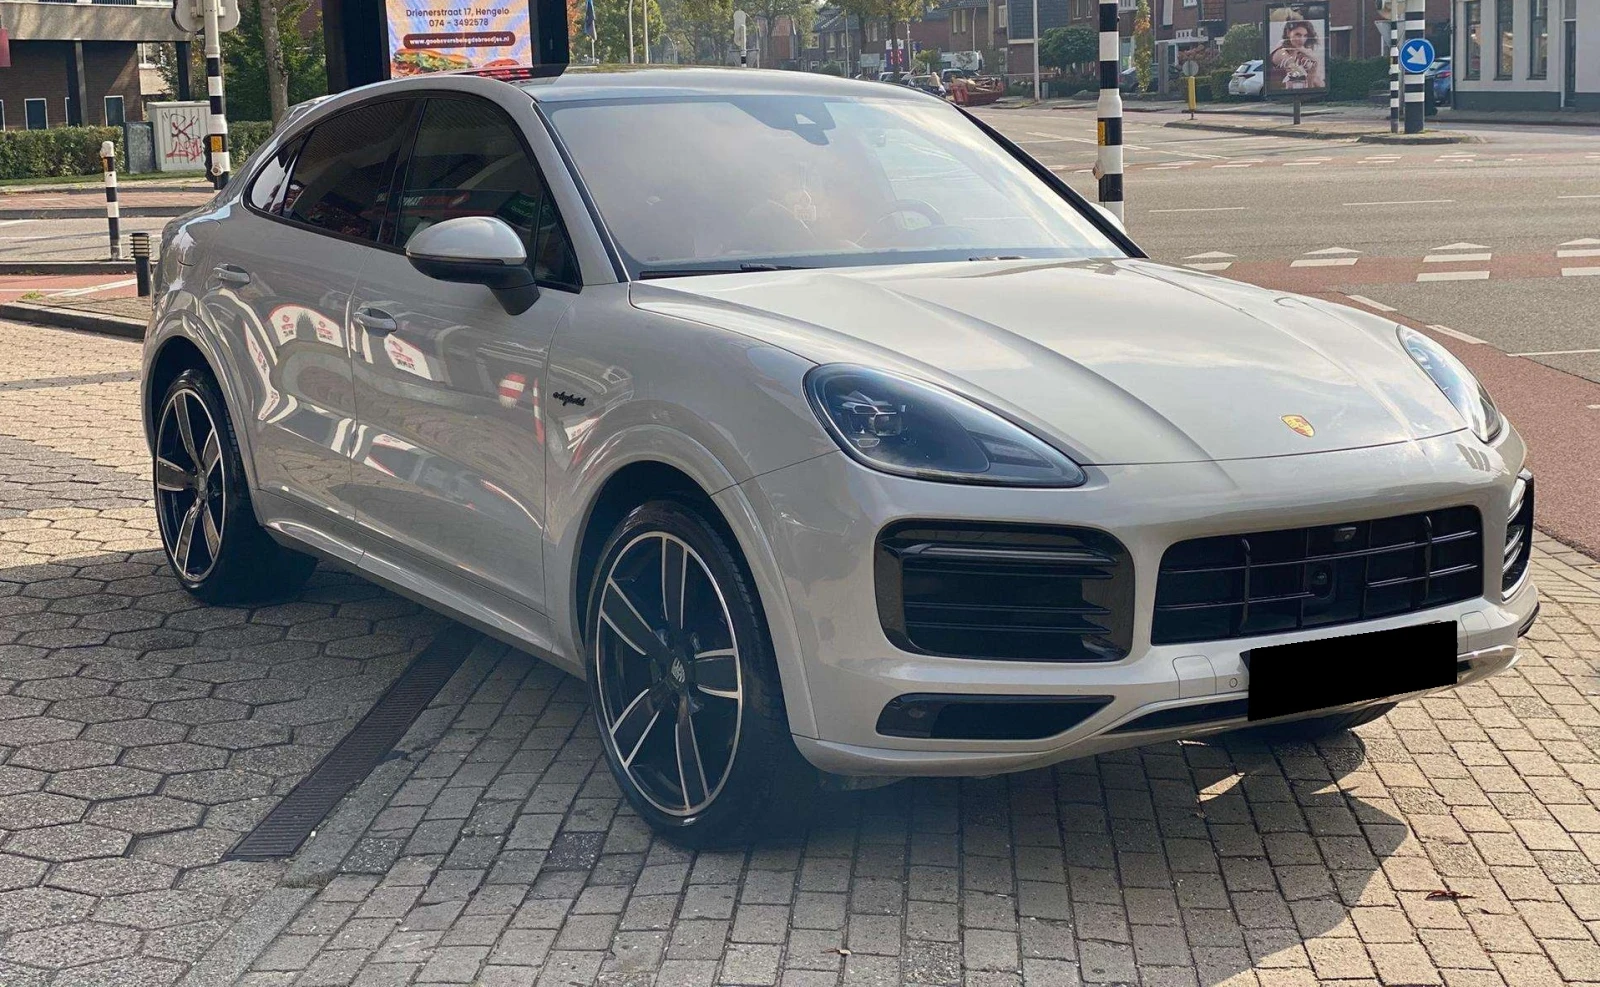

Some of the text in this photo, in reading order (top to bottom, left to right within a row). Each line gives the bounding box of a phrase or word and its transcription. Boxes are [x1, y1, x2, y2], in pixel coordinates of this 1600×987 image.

[406, 7, 510, 17] Drienerstraat 17, Hengelo
[429, 19, 444, 27] 074
[453, 18, 489, 26] 3492578
